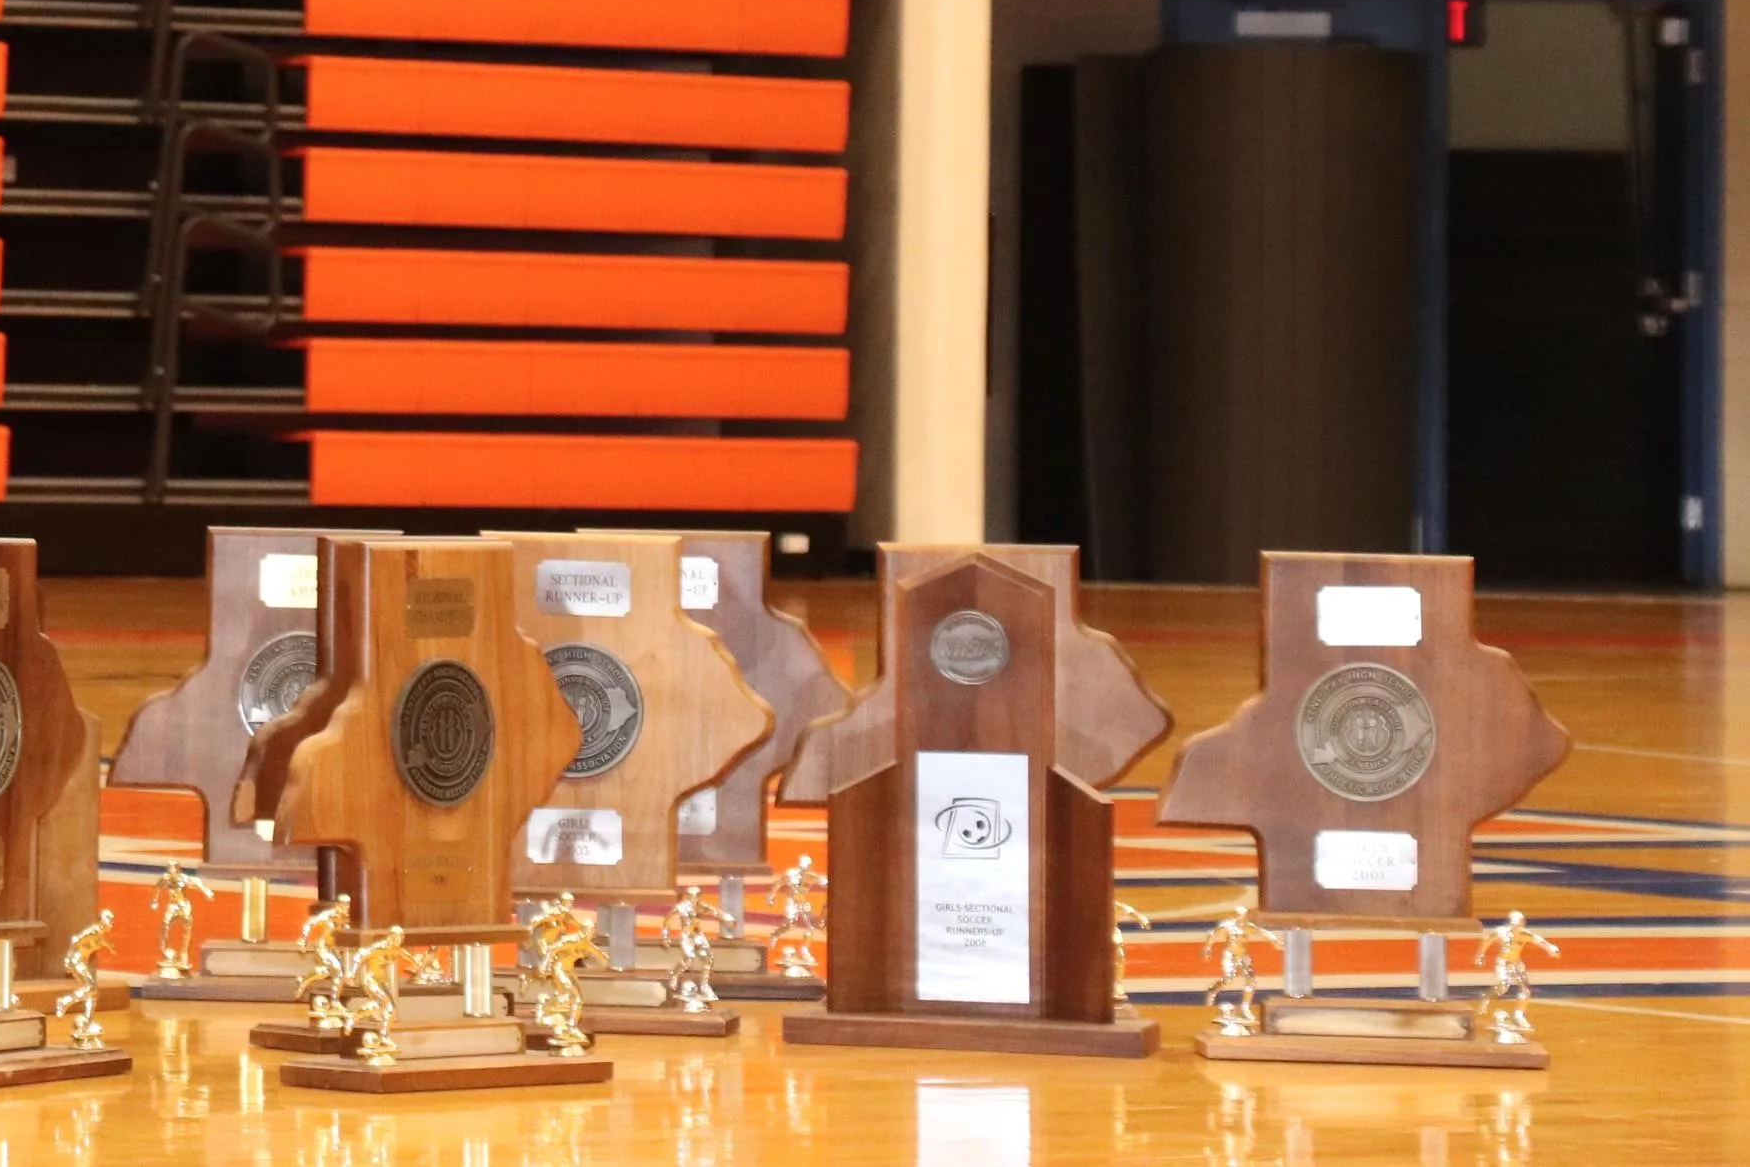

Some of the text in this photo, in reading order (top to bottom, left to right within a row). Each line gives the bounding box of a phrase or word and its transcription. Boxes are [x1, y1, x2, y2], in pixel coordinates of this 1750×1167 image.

[550, 574, 619, 587] SECTIONAL
[545, 590, 624, 605] RUNNER-UP
[558, 818, 591, 829] GIRLS
[1342, 856, 1396, 868] OCCER
[935, 902, 1014, 914] GIRLS SECTIONAL
[956, 915, 994, 925] SOCCER
[946, 926, 1006, 937] RUNNERS-UP
